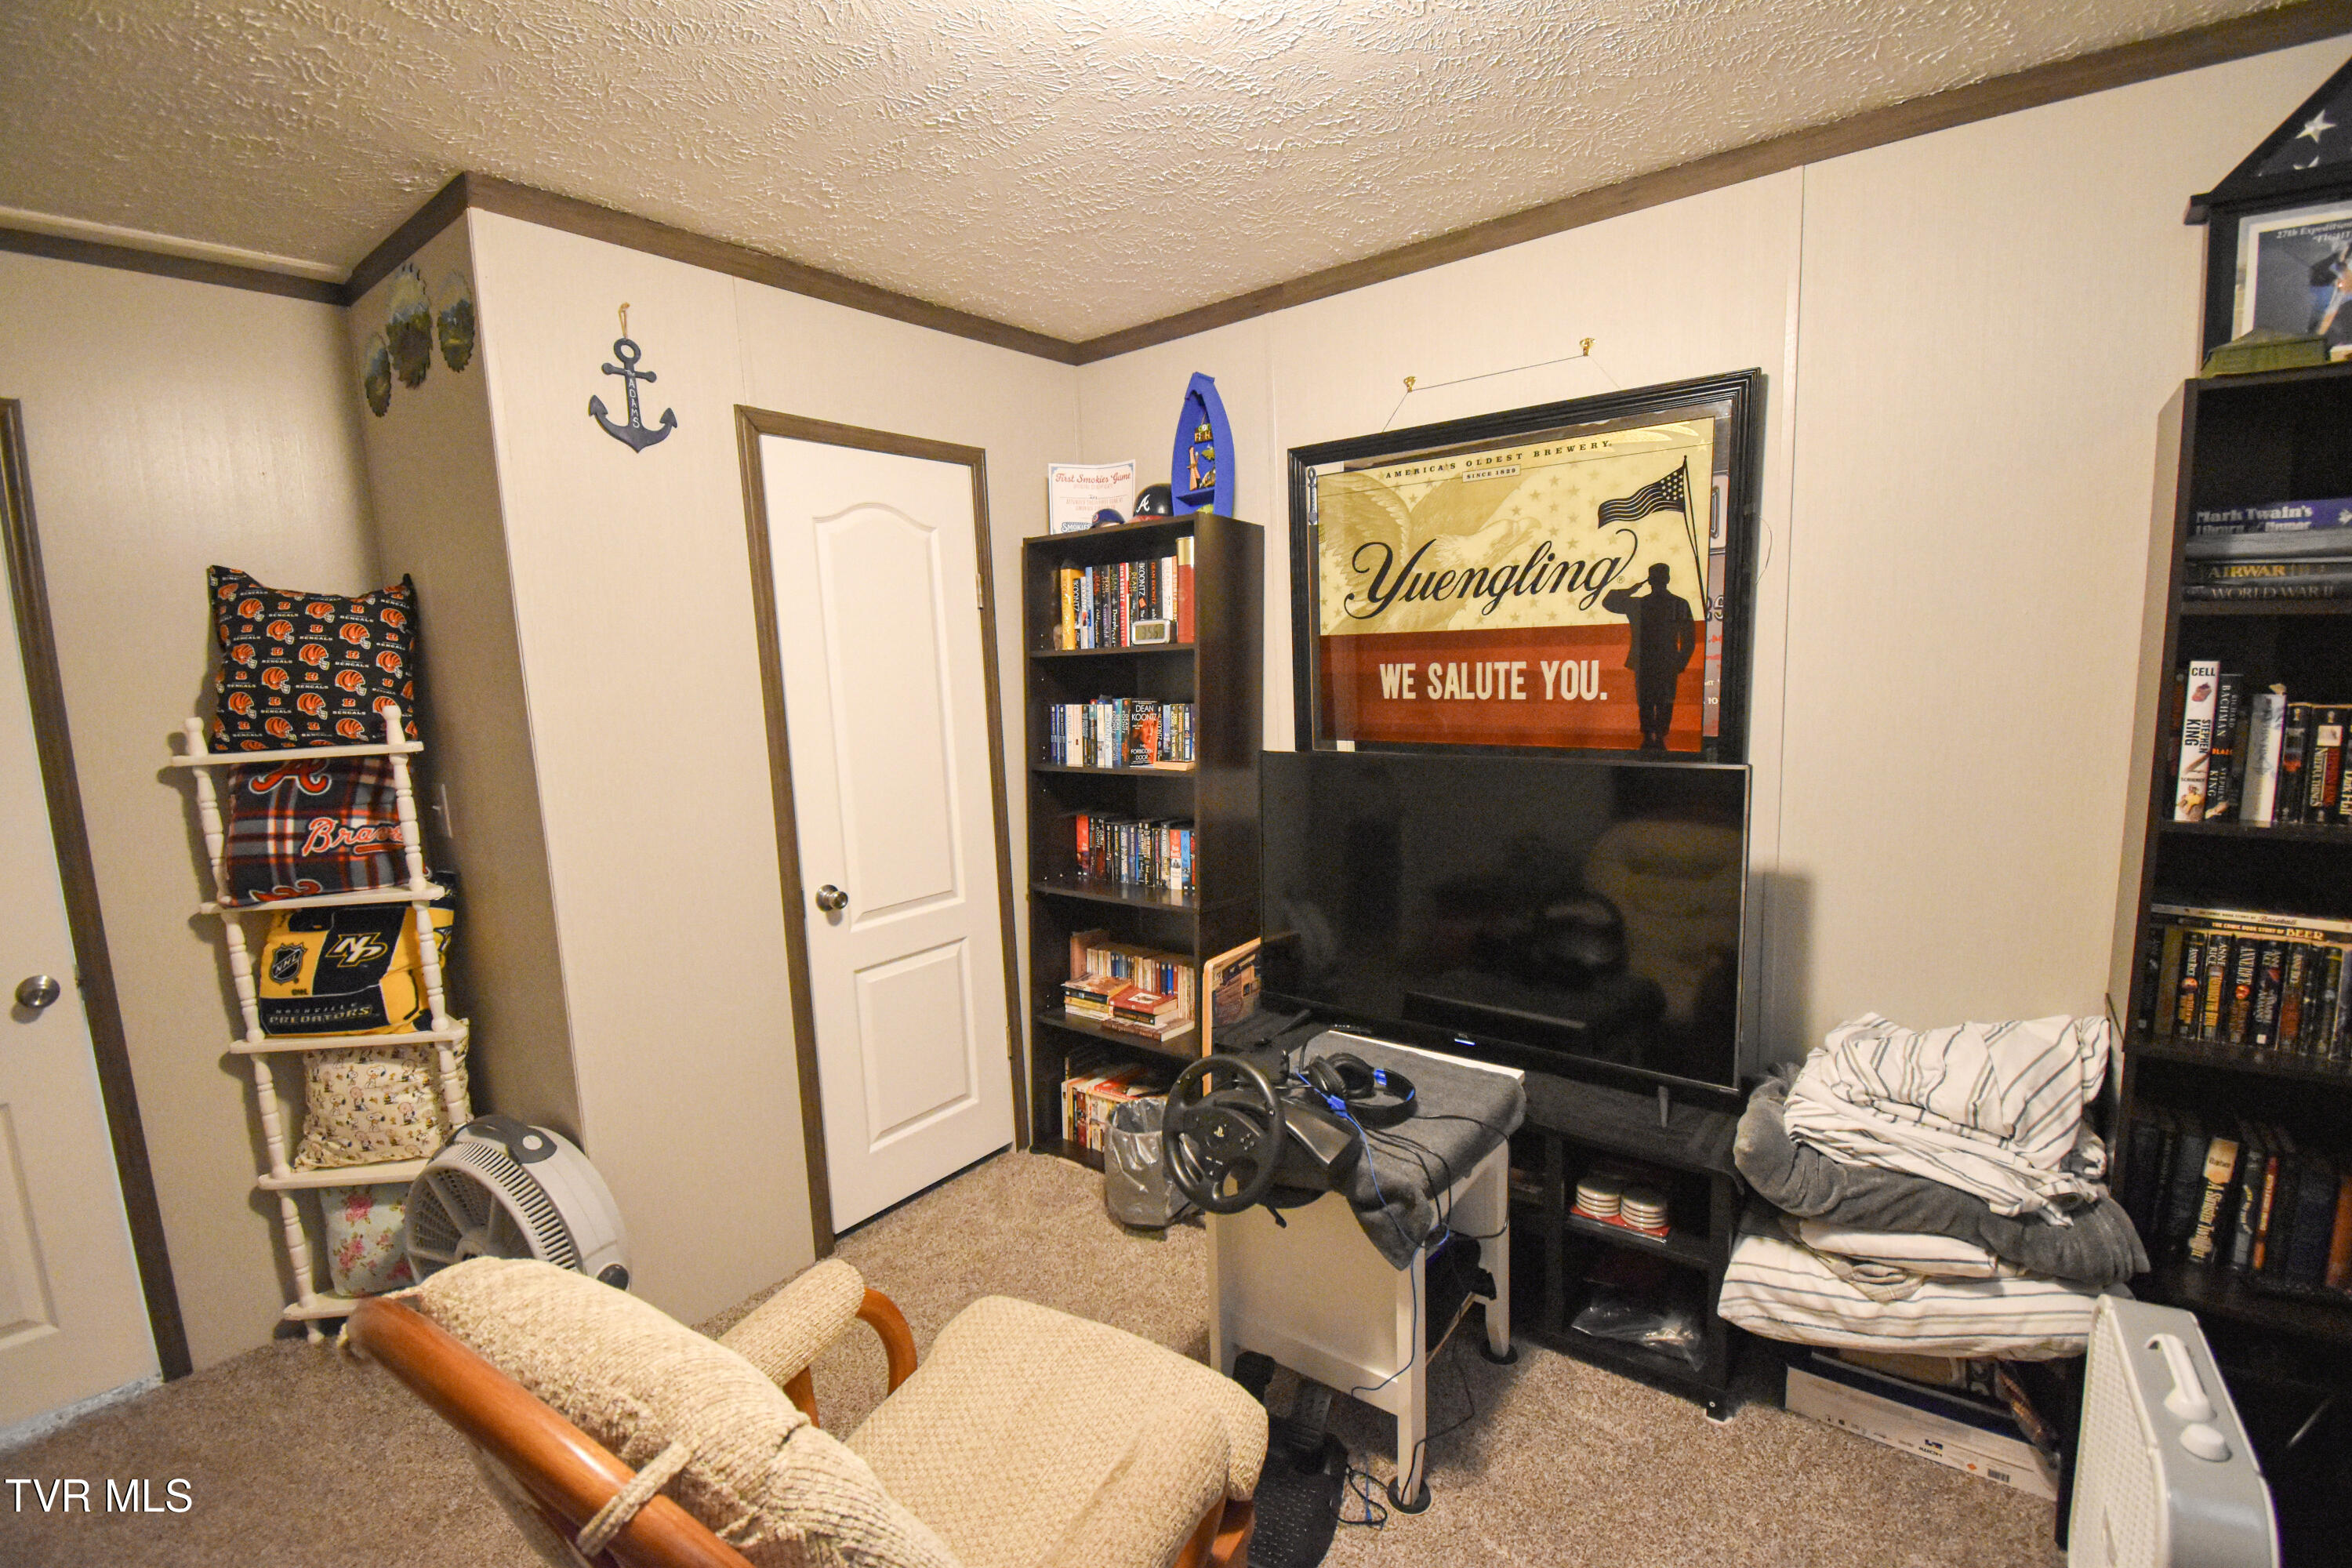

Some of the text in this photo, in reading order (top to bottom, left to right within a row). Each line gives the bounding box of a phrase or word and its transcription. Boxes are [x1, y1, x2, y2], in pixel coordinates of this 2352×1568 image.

[628, 378, 641, 429] ADAMS
[1385, 463, 1456, 479] AMERICA'S
[1465, 452, 1523, 467] OLDEST
[1466, 471, 1492, 480] SINCE
[1055, 472, 1131, 485] First Smokies Game
[2196, 505, 2313, 523] Mark Twain's
[1344, 528, 1638, 620] Yuengling
[1379, 659, 1608, 701] WE SALUTE YOU.
[2190, 667, 2216, 677] CELL
[1131, 713, 1157, 721] KOONTZ
[1135, 704, 1154, 713] DEAN
[2216, 684, 2232, 737] BACHMAN
[2184, 718, 2201, 746] KING
[2198, 719, 2212, 754] STEPHEN
[2207, 770, 2219, 797] KING
[2285, 927, 2325, 941] BEER
[274, 952, 299, 974] NHL
[2207, 946, 2218, 966] RICE
[2217, 942, 2228, 967] ANNE
[2239, 946, 2256, 967] ANNE
[2236, 967, 2254, 985] RICE
[269, 1004, 373, 1025] PREDATORS
[2205, 1181, 2225, 1192] A
